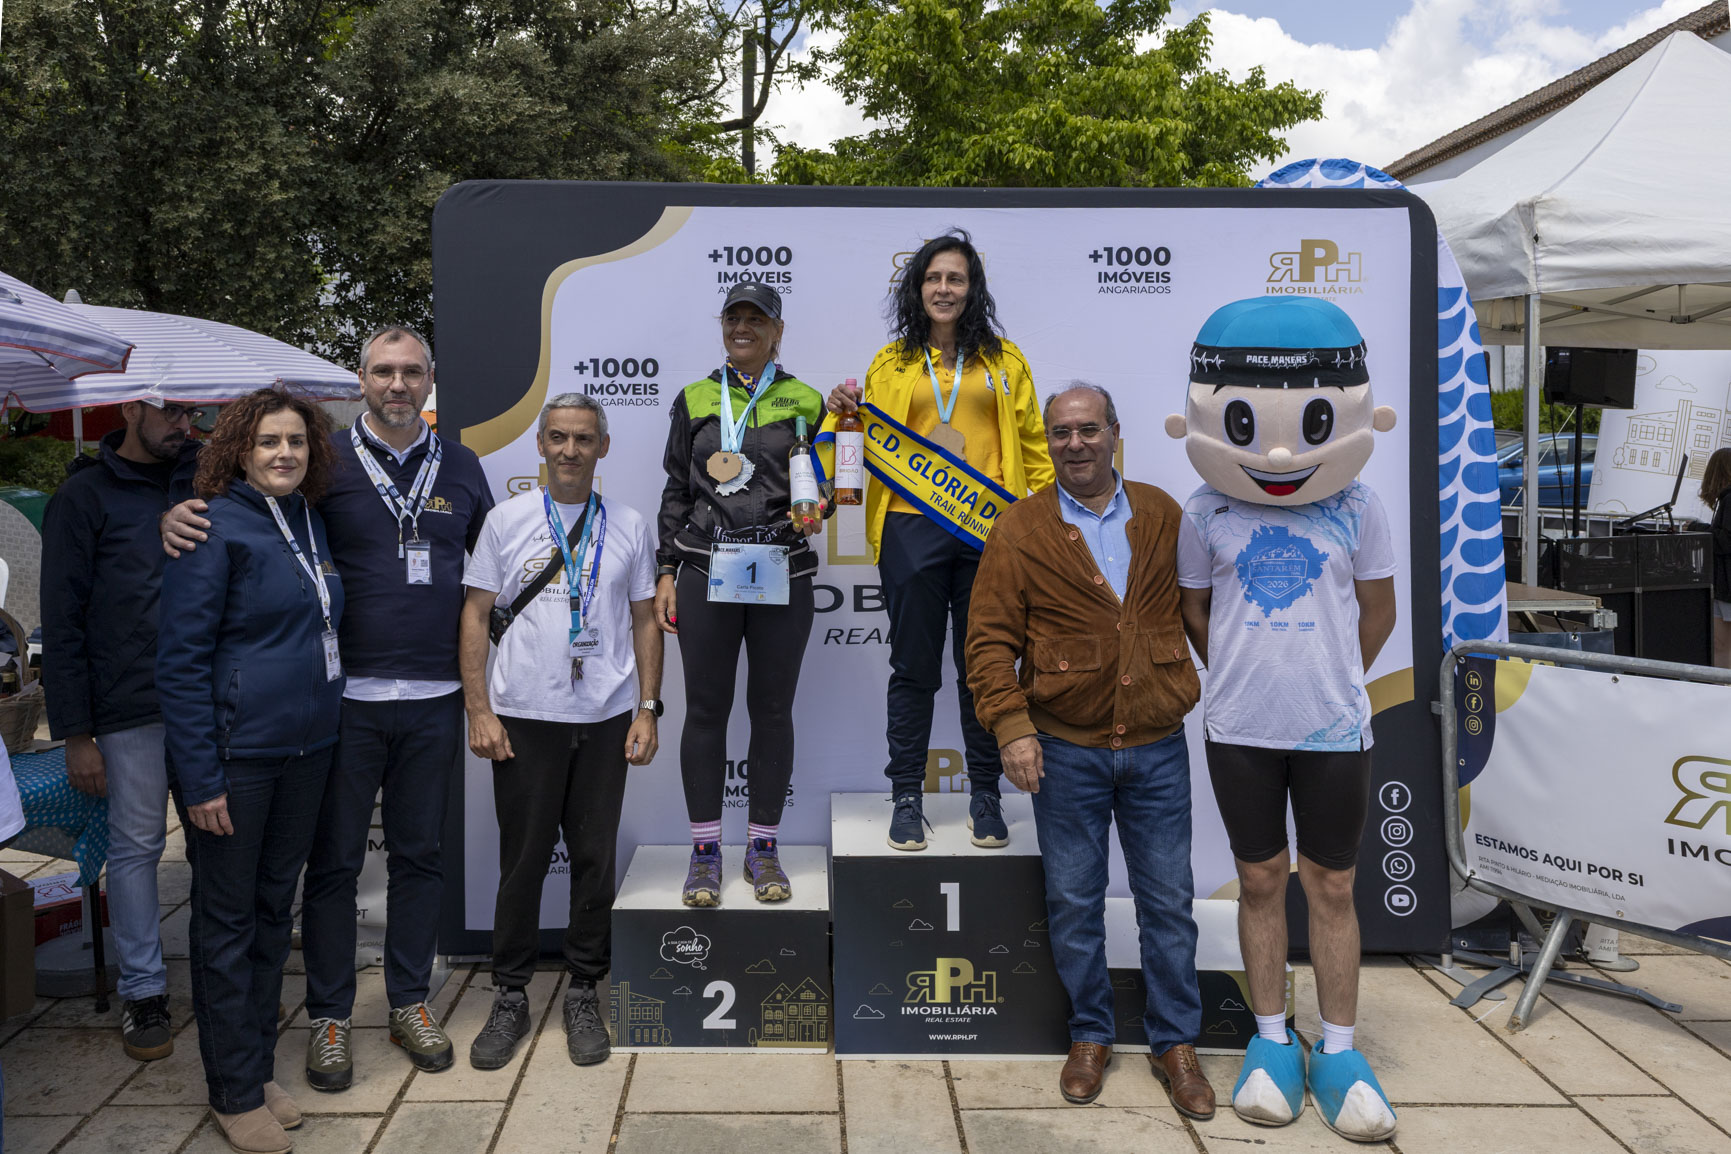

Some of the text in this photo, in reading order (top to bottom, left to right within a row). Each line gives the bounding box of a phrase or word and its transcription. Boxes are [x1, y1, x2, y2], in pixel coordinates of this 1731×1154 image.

[708, 246, 793, 266] +1000
[1089, 246, 1171, 266] +1000
[718, 268, 792, 283] IMÓVEIS
[1098, 268, 1171, 283] IMÓVEIS
[1098, 286, 1171, 294] ANGARIADOS
[1266, 284, 1364, 294] IMOBILIÁRIA
[1246, 355, 1307, 364] PACE MAKERS
[574, 358, 659, 378] +1000
[584, 380, 659, 395] IMÓVEIS
[598, 398, 659, 407] GARIADOS
[867, 423, 1002, 522] C.D. GLÓRIA D
[930, 491, 990, 537] TRAIL RUNNI
[746, 562, 757, 584] 1
[1475, 833, 1645, 887] ESTAMOS AQUI POR SI
[1612, 893, 1626, 902] LDA
[940, 882, 960, 931] 1
[676, 938, 703, 952] sonho
[702, 980, 737, 1030] 2
[901, 1005, 998, 1015] IMOBILIÁRIA
